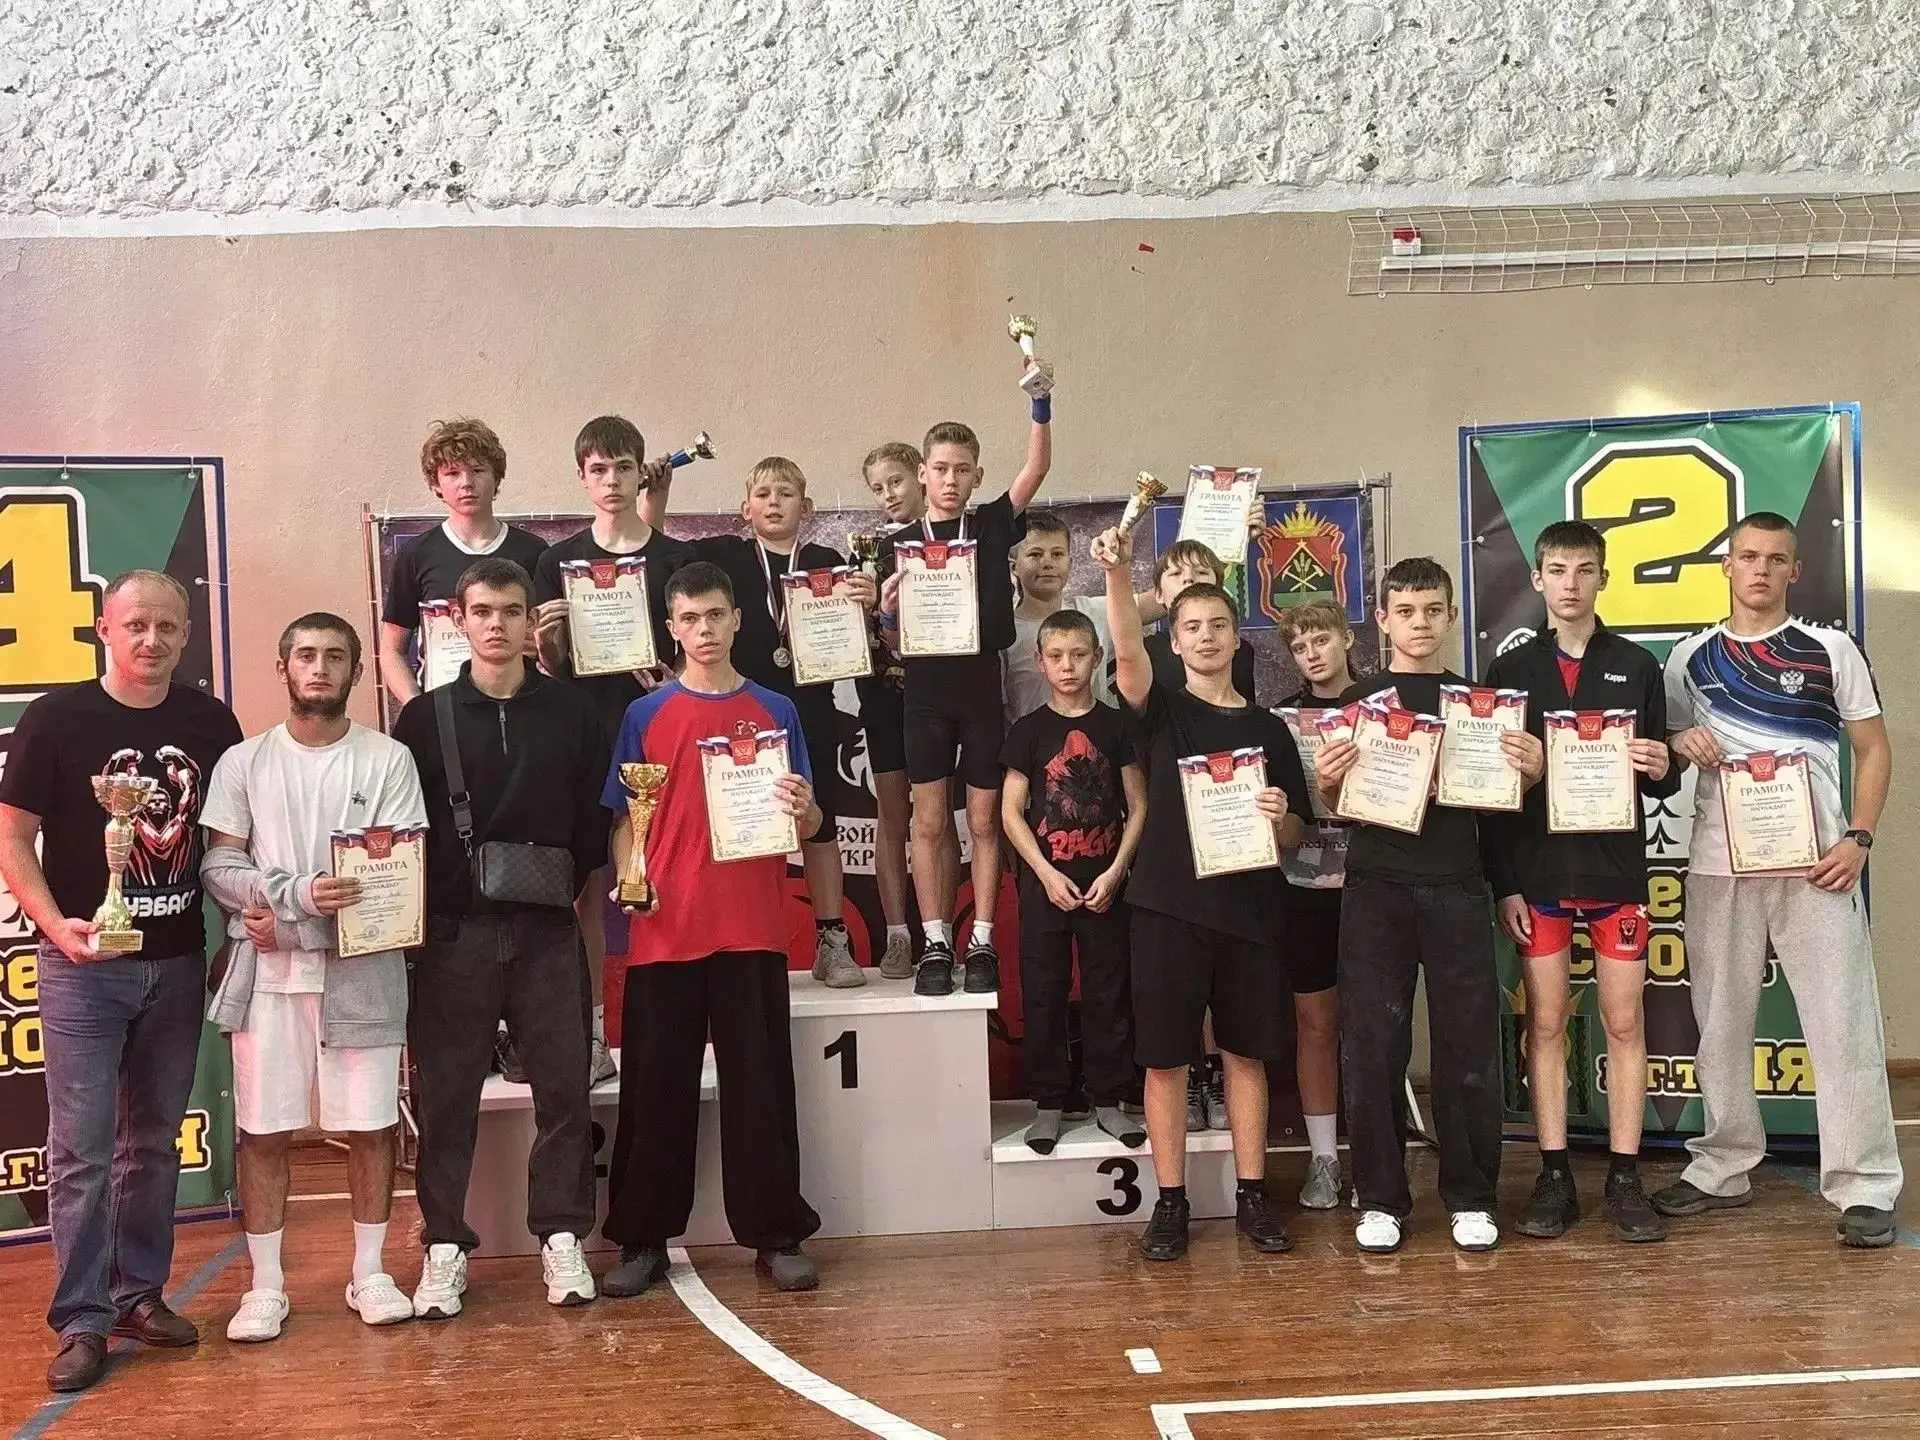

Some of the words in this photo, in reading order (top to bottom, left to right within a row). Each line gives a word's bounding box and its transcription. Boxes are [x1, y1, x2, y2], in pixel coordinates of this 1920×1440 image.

[1200, 493, 1242, 502] ГРАМОТА
[1573, 447, 1737, 634] 2
[913, 572, 961, 582] ГРАМОТА
[0, 496, 99, 690] 4
[583, 591, 632, 603] ГРАМОТА
[801, 597, 848, 611] ГРАМОТА
[1604, 672, 1627, 683] Kappa
[1457, 720, 1506, 732] ГРАМОТА
[1369, 738, 1420, 757] ГРАМОТА
[1565, 744, 1618, 753] ГРАМОТА
[721, 766, 774, 781] ГРАМОТА
[1201, 783, 1251, 798] ГРАМОТА
[1740, 783, 1794, 797] ГРАМОТА
[354, 860, 408, 875] ГРАМОТА
[823, 1030, 859, 1089] 1
[1095, 1158, 1143, 1216] 3
